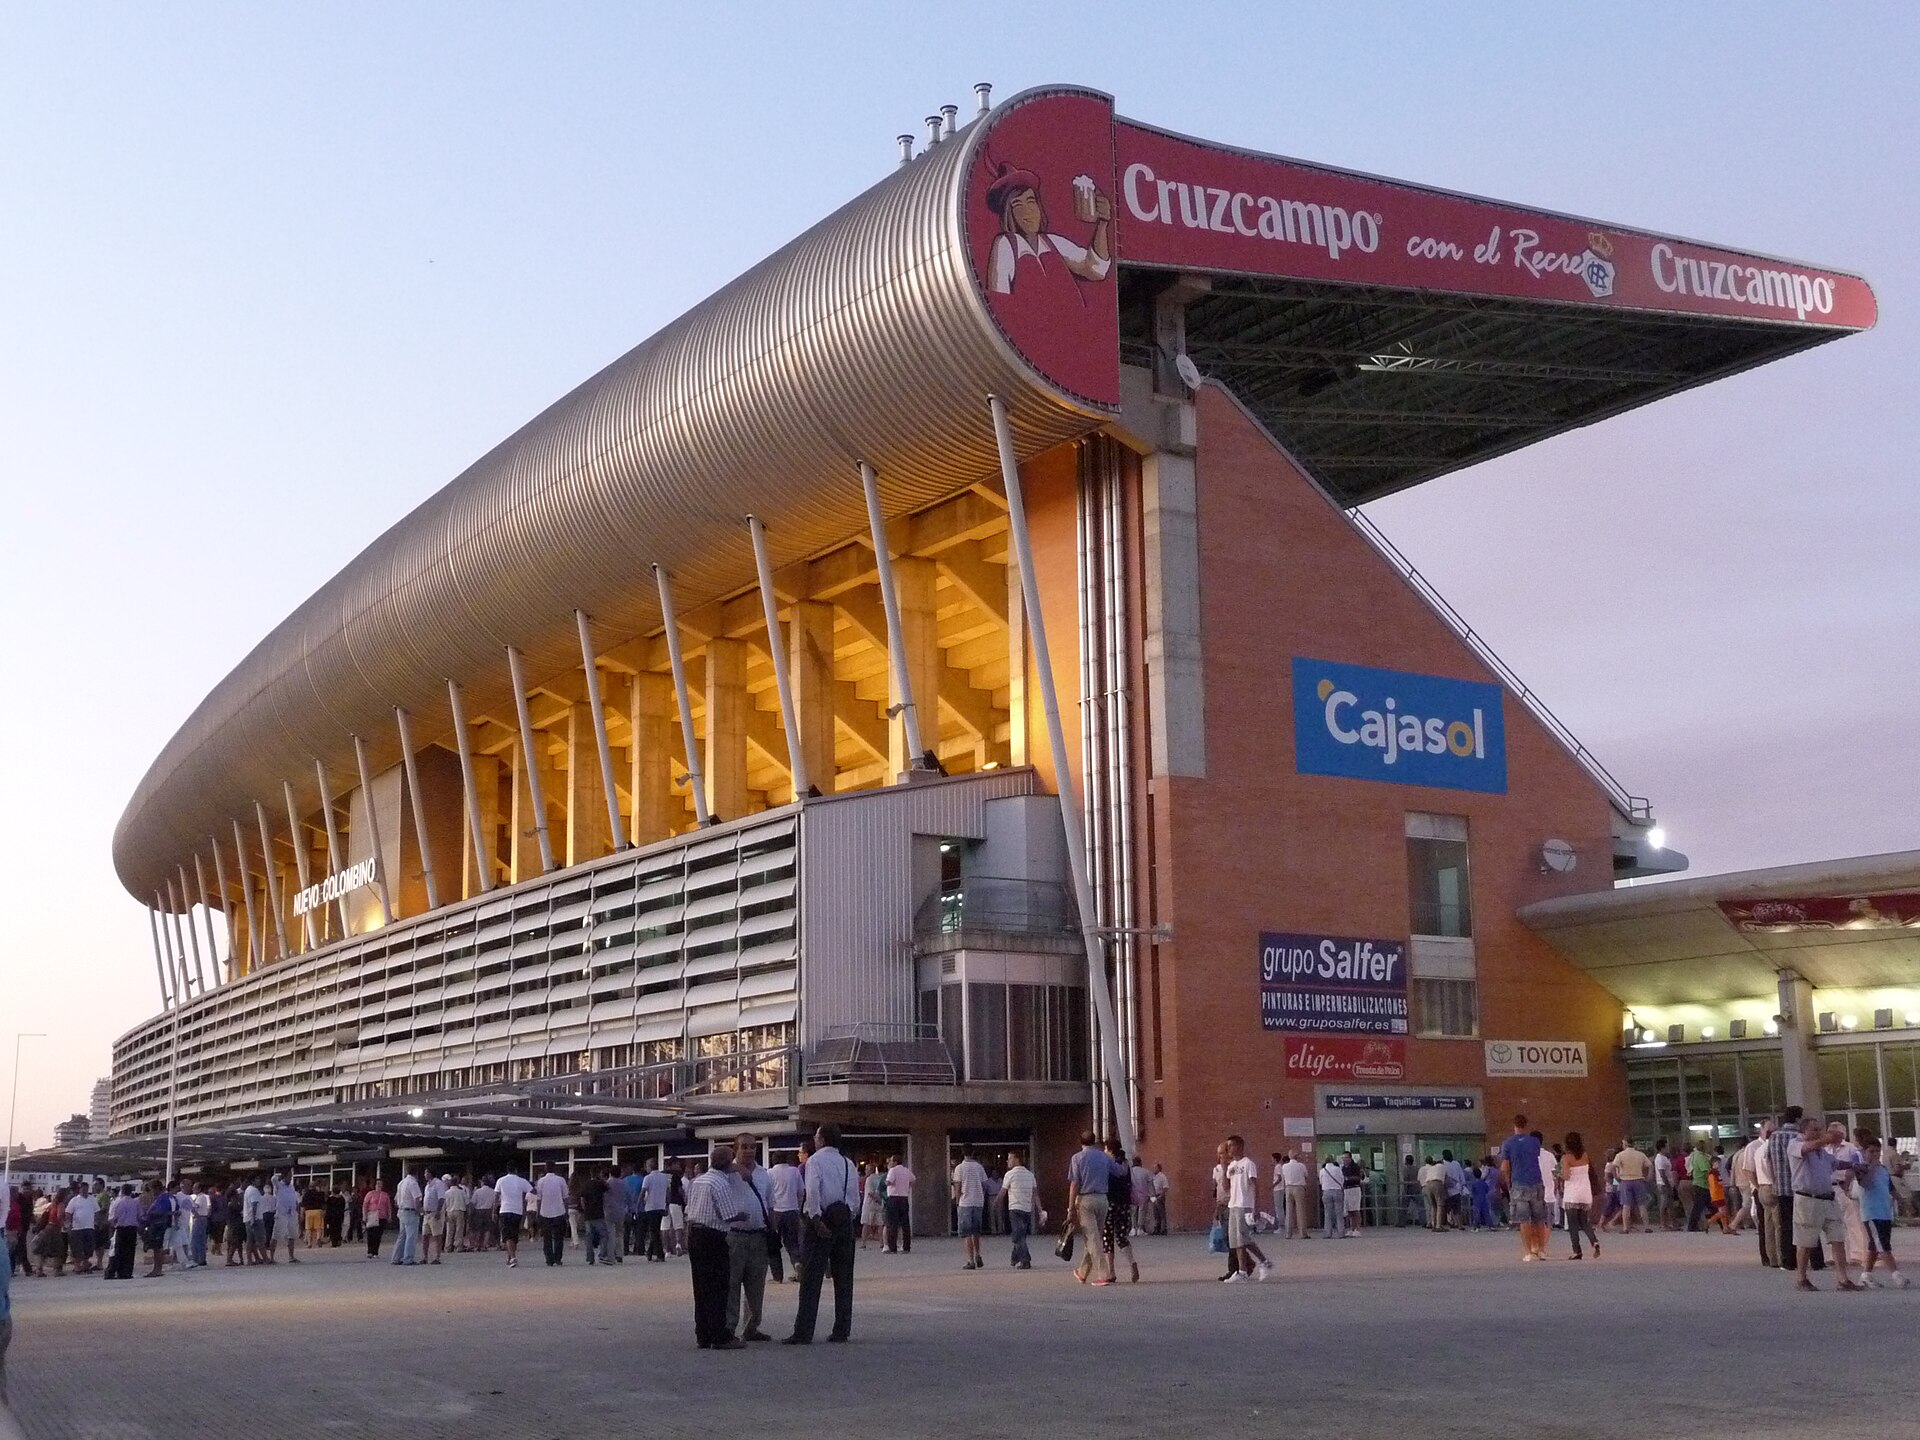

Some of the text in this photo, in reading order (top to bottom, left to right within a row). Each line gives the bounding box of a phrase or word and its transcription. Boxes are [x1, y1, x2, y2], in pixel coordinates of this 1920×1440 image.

[1123, 163, 1379, 260] Cruzcampo
[1406, 234, 1463, 262] con
[1474, 226, 1501, 264] el
[1651, 243, 1833, 320] Cruzcampo
[1325, 690, 1485, 765] Cajasol
[293, 857, 376, 917] NUEVO COLOMBINO
[1263, 939, 1398, 981] grupo Salfer
[1262, 991, 1408, 1015] PINTURAS E IMPERMEABILIZACIONES
[1264, 1017, 1389, 1030] www.gruposalfer.es
[1288, 1043, 1351, 1077] elige...
[1517, 1046, 1584, 1064] TOYOTA
[1383, 1097, 1422, 1108] Taquillas
